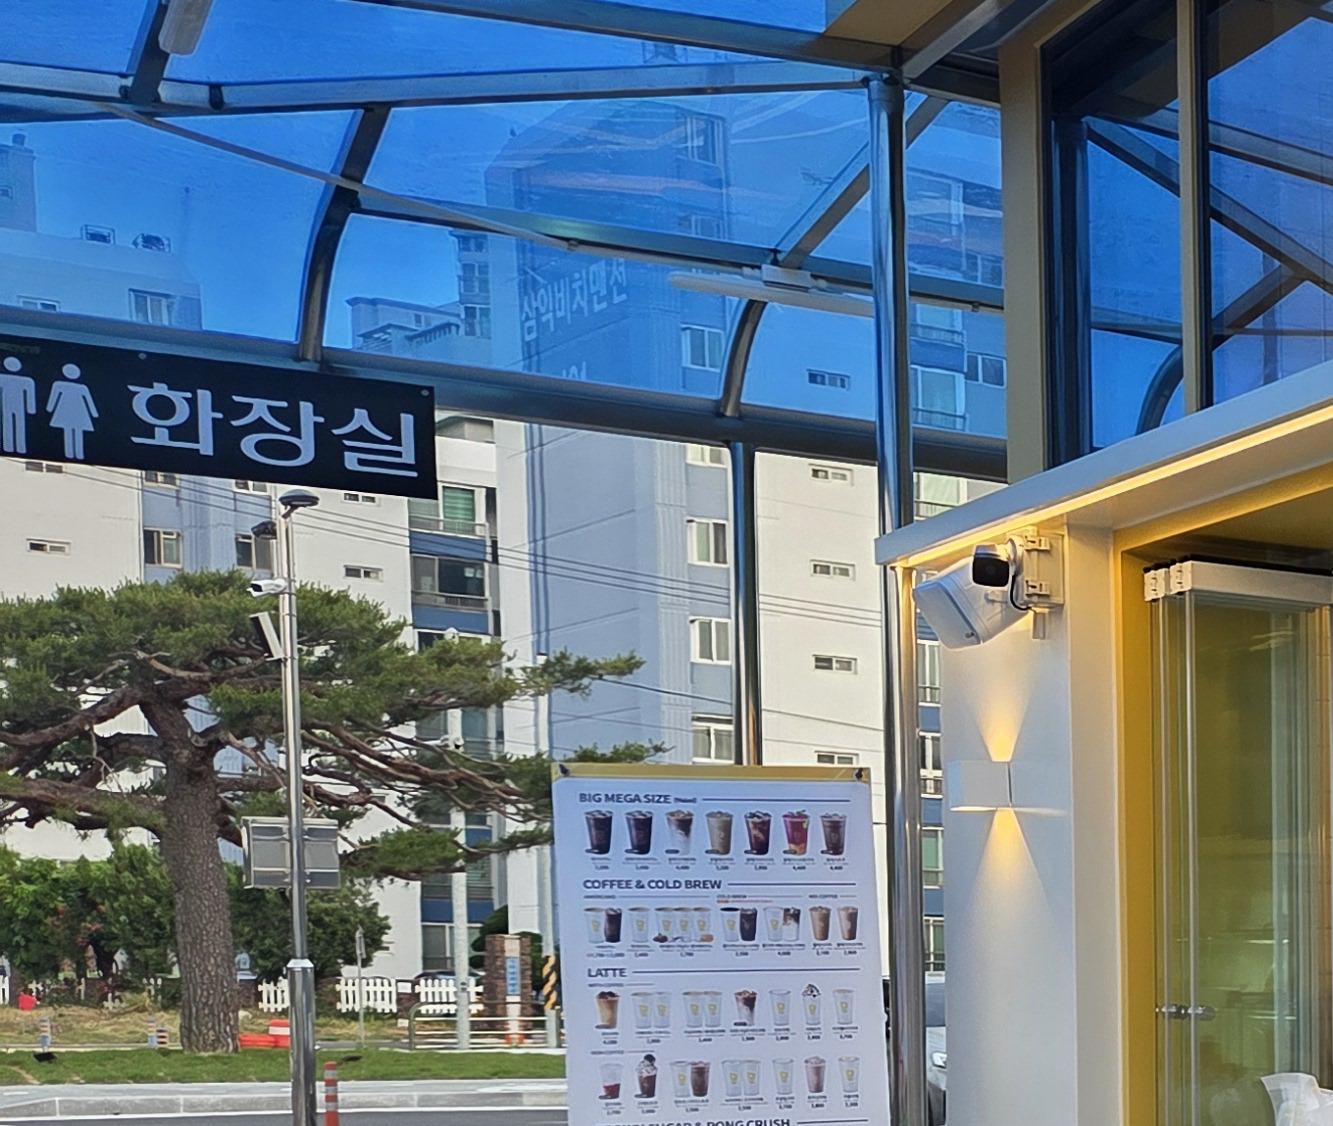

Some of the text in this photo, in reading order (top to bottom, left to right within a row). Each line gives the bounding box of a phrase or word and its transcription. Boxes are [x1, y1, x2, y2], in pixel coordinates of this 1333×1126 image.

[127, 381, 419, 478] 화장실
[579, 793, 602, 803] BIG
[604, 793, 641, 804] MEGA
[643, 794, 671, 804] SIZE
[583, 879, 722, 889] COFFEE & COLD BREW
[587, 968, 627, 978] LATTE
